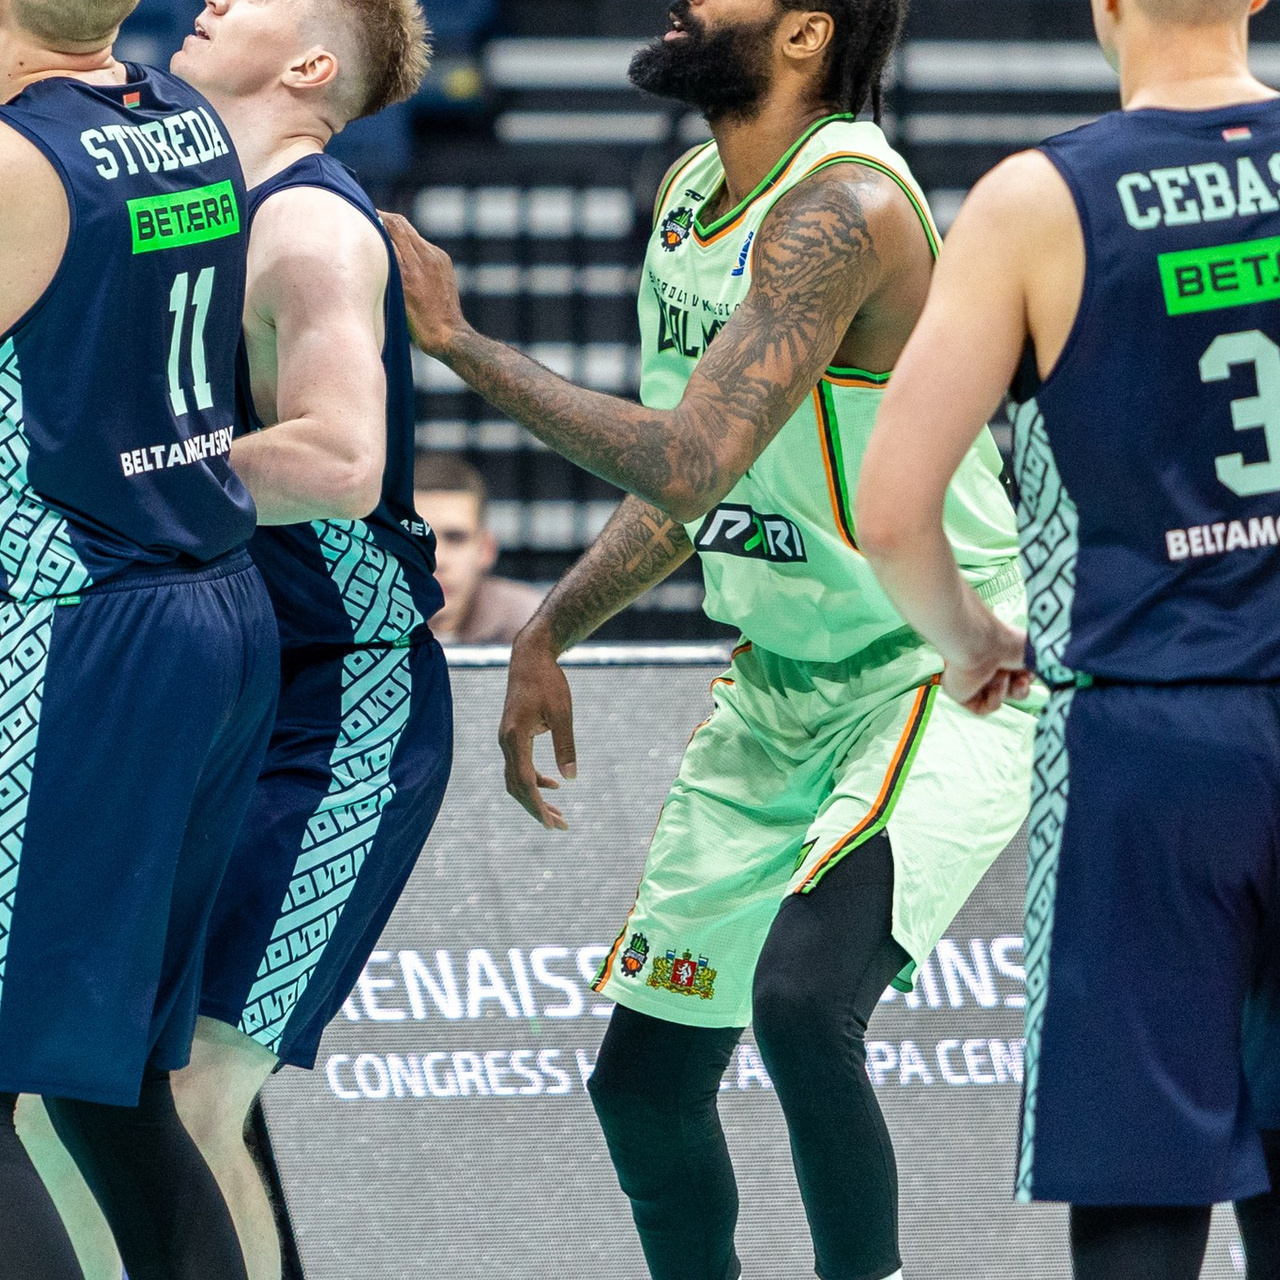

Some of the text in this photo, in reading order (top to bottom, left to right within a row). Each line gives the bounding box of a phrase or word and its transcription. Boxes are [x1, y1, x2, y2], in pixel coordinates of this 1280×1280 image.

[80, 106, 230, 180] STUBEDA
[167, 266, 215, 417] 11
[1165, 516, 1280, 560] BELTAM
[325, 1047, 571, 1100] CONGRESS
